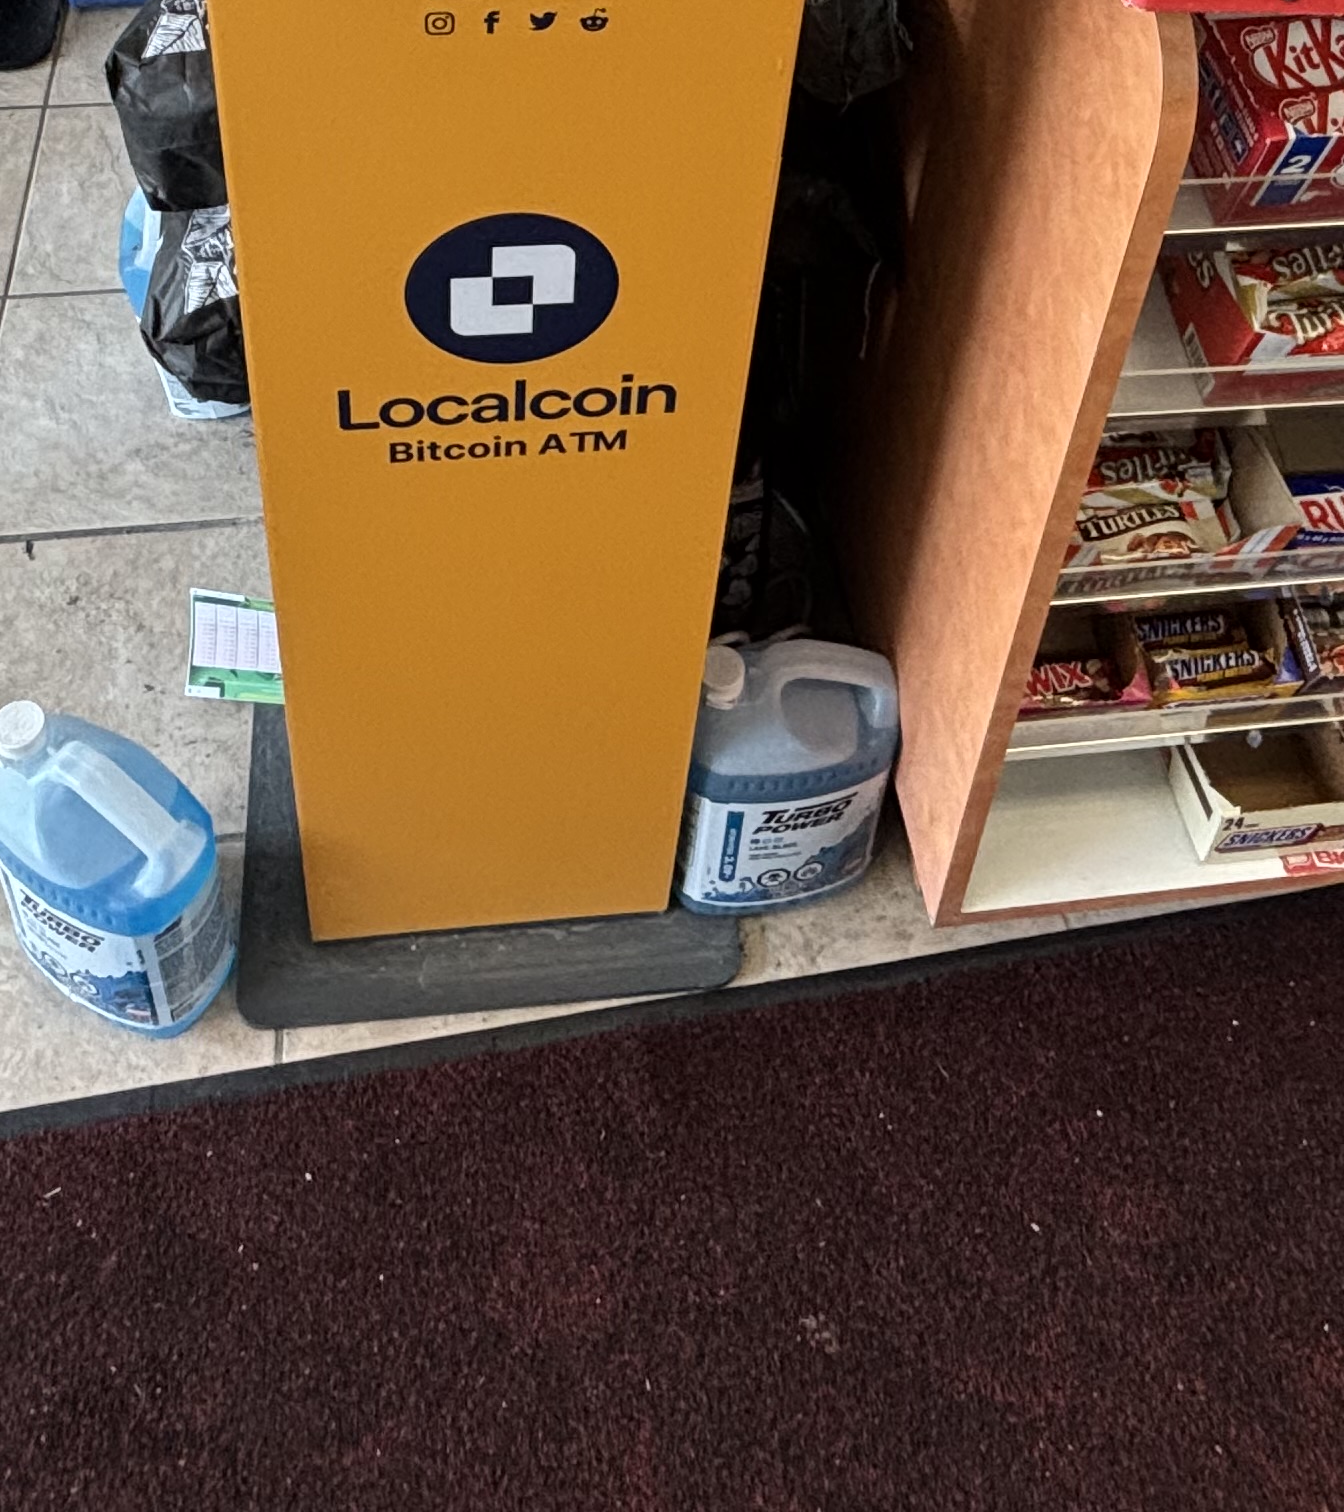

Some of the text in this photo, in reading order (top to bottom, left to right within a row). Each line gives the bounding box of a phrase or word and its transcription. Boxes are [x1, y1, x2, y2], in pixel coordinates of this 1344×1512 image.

[1286, 155, 1310, 173] 2
[337, 373, 678, 431] Localcoin
[389, 429, 628, 464] Bitcoin ATM
[1080, 505, 1181, 538] TURTLES
[1136, 614, 1224, 641] SNICKERS
[1169, 650, 1259, 680] SNICKERS
[752, 812, 844, 835] POWER
[762, 798, 853, 825] TURBO
[1224, 817, 1245, 832] 24
[1224, 826, 1313, 849] SNICKERS
[19, 889, 104, 947] TURBO
[20, 899, 97, 954] POWER
